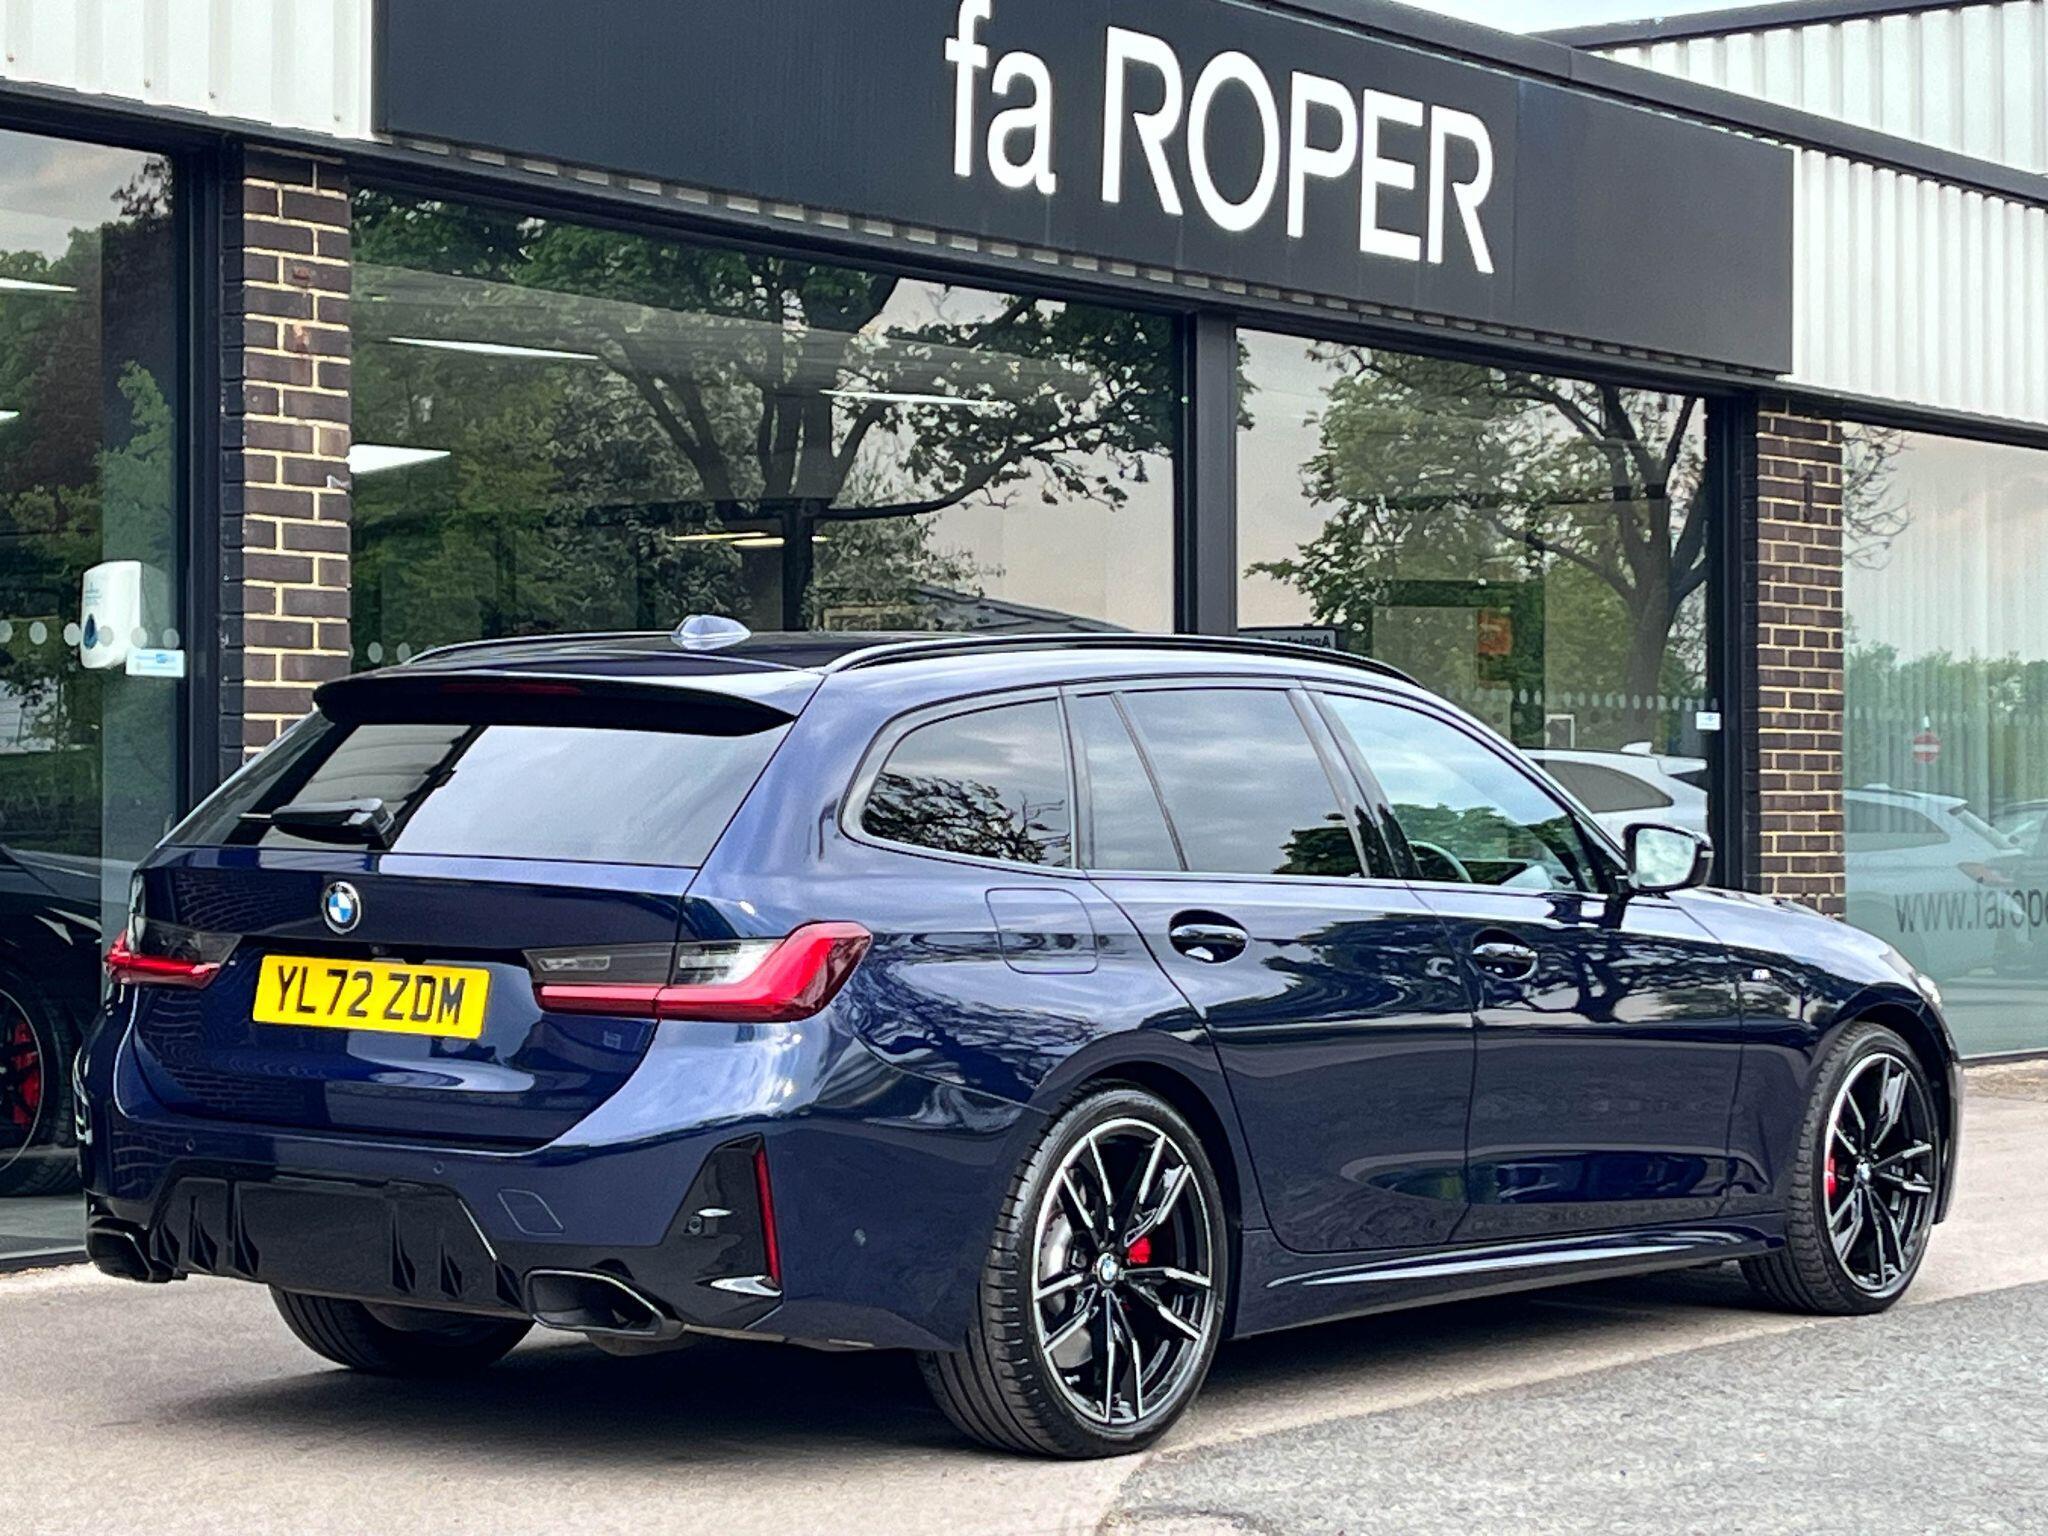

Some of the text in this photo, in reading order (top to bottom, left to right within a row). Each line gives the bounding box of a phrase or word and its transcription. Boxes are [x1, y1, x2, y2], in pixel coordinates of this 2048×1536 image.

[945, 0, 1495, 274] fa ROPER
[1895, 889, 2048, 941] www.farop
[278, 966, 466, 1024] YL72 ZDM
